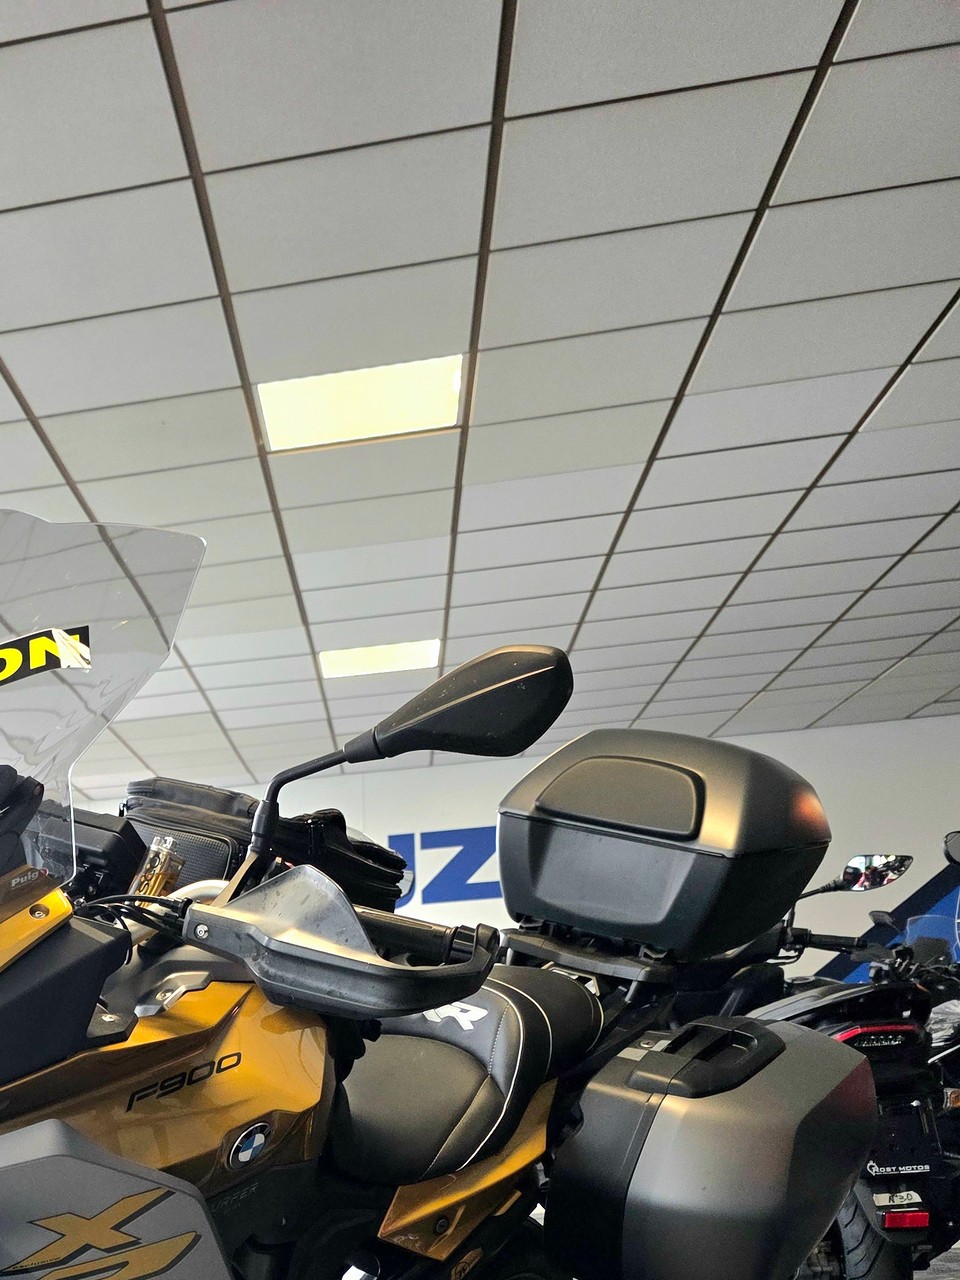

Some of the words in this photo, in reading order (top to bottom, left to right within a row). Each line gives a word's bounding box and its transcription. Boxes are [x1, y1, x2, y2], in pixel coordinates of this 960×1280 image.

[11, 870, 39, 887] Puig
[125, 1053, 242, 1113] F900
[872, 1165, 897, 1173] ROST
